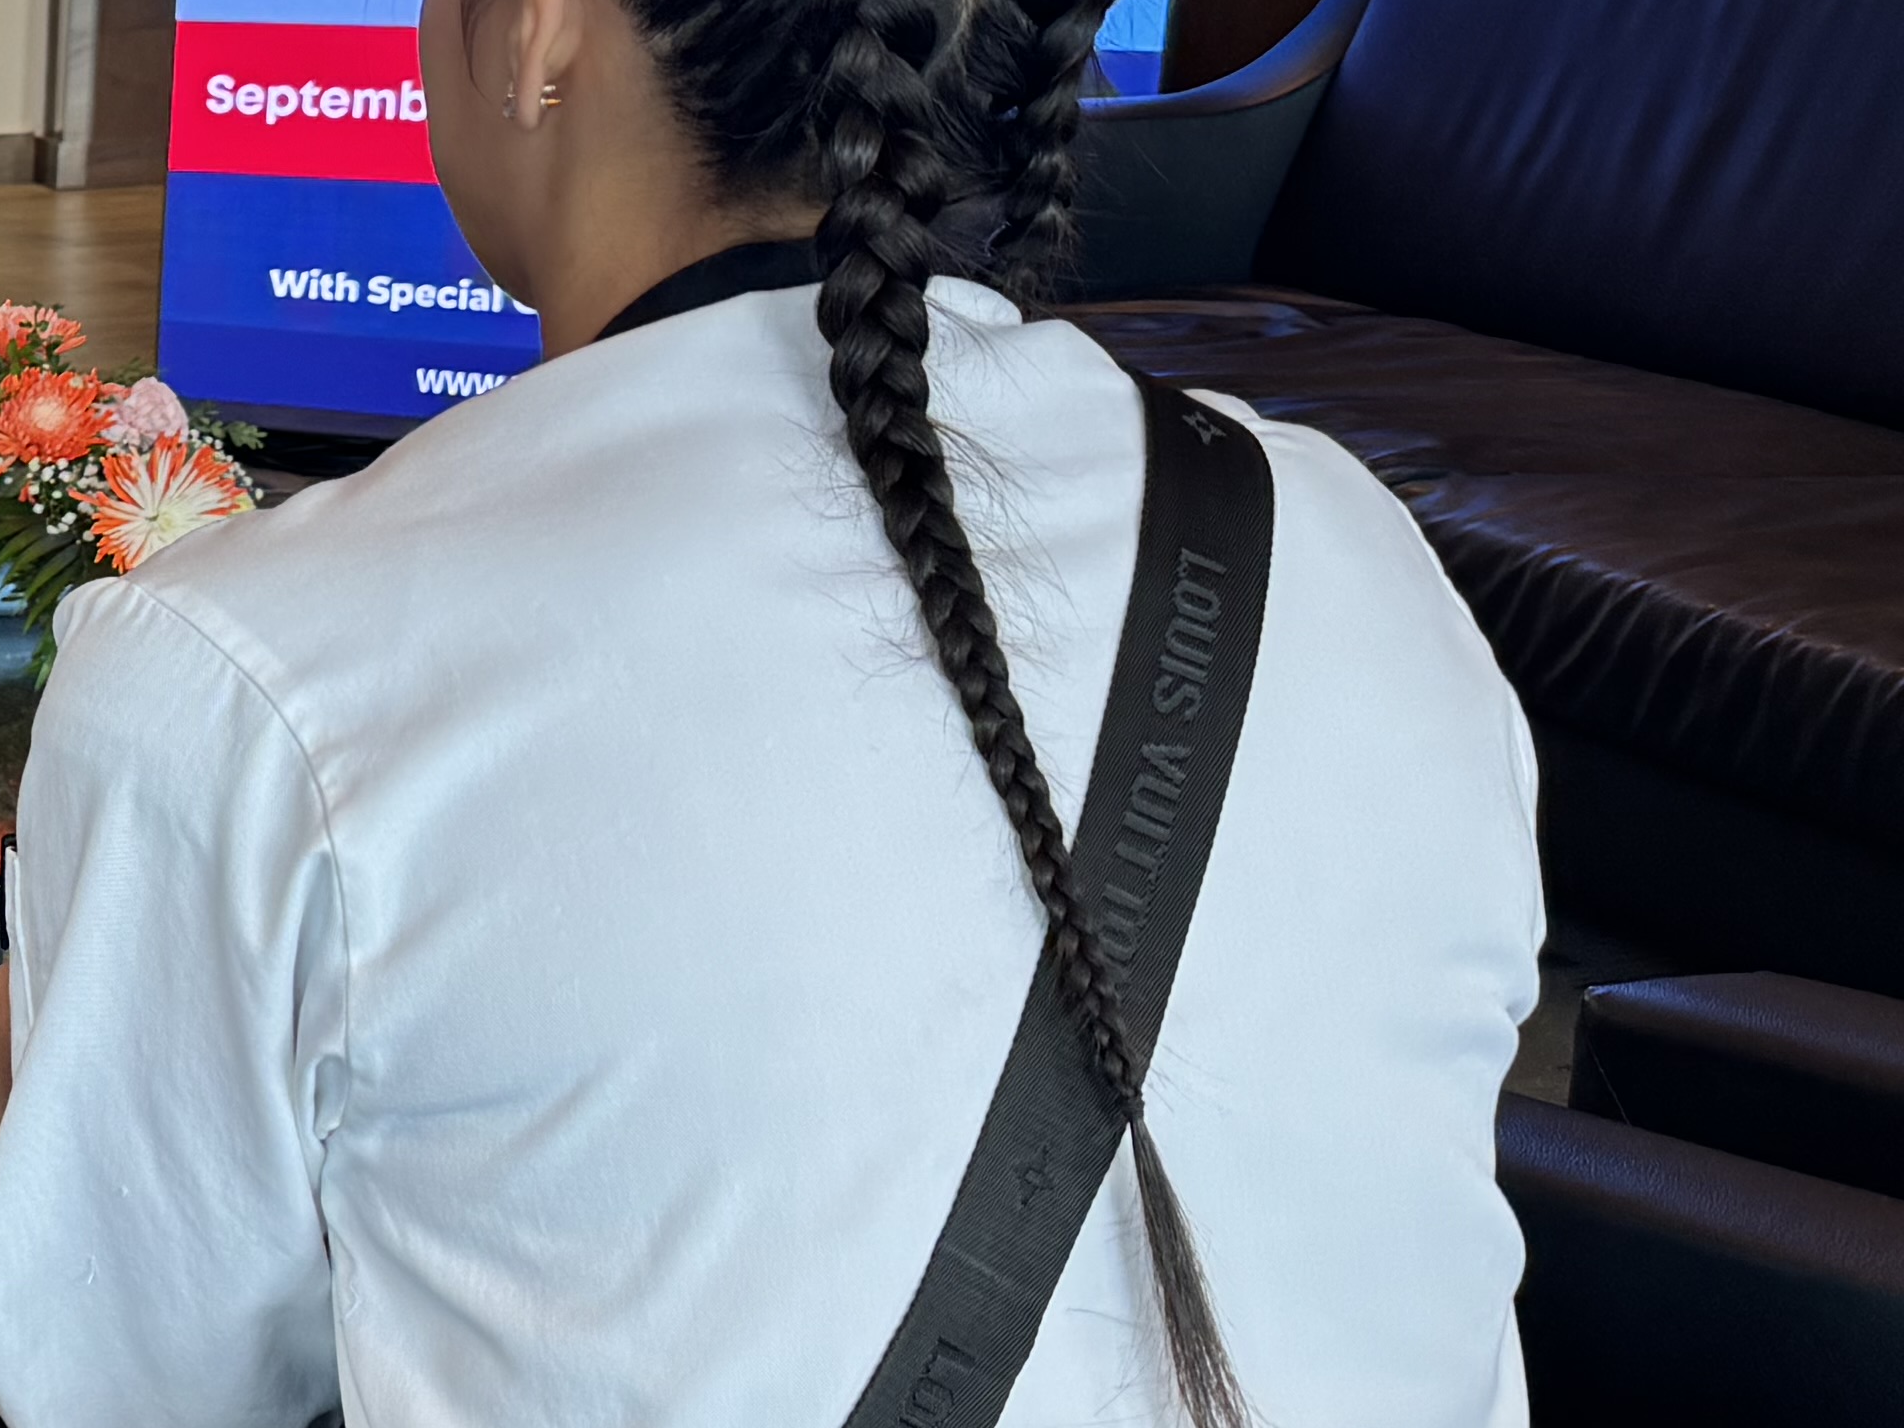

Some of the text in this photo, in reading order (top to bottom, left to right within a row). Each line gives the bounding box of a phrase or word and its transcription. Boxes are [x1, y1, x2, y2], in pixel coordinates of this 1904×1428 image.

[269, 268, 360, 303] With
[366, 275, 503, 313] Special
[1095, 547, 1228, 966] LOUIS VUITTO
